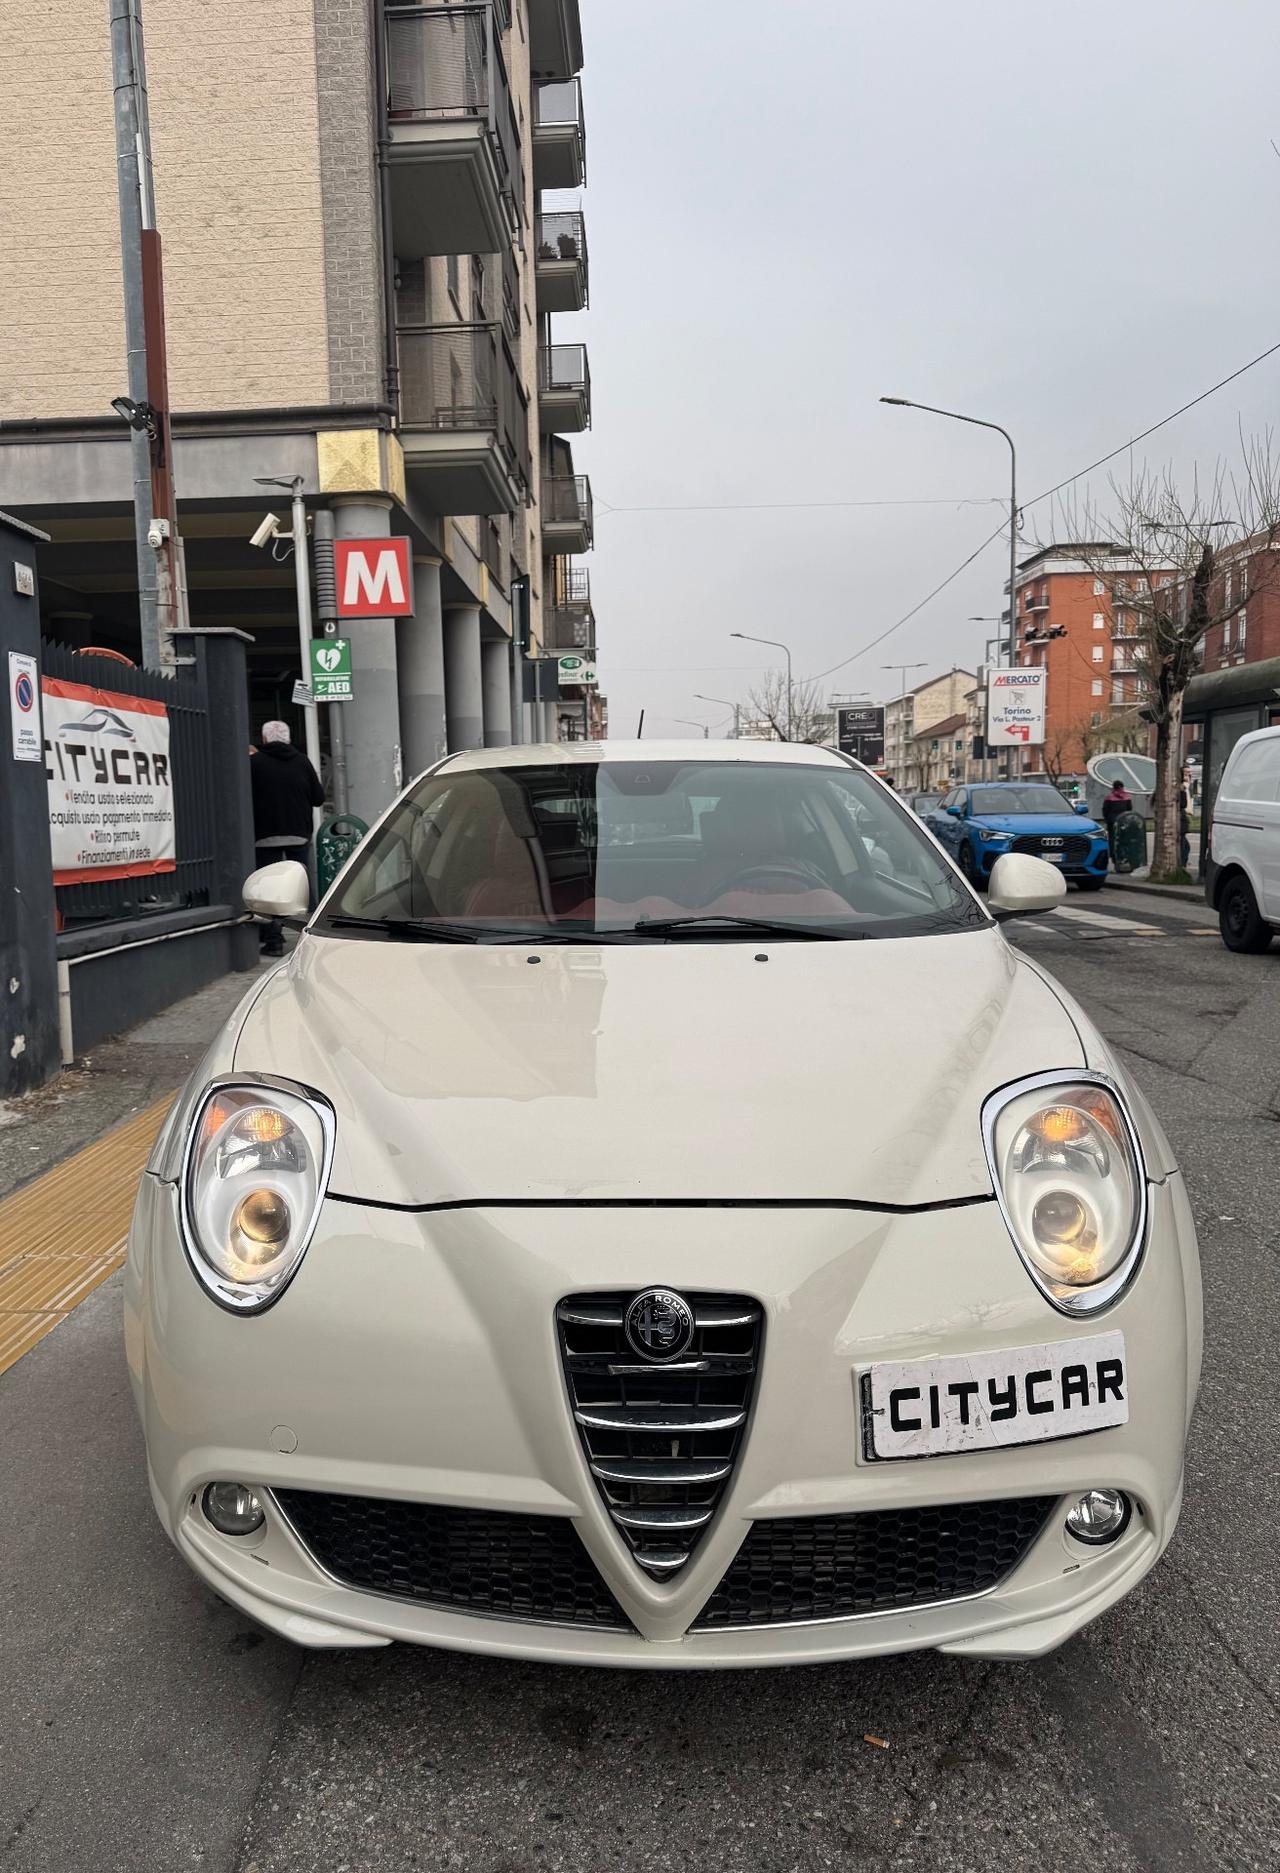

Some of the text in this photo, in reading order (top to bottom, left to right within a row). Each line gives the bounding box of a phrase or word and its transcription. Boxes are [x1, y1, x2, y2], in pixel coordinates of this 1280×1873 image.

[343, 550, 406, 605] M
[327, 682, 350, 693] AED
[1003, 706, 1031, 715] Torino
[98, 792, 115, 805] usato
[116, 790, 154, 805] selezionato
[48, 809, 81, 828] cquisto
[82, 810, 101, 825] usato
[142, 809, 173, 823] immediato
[81, 848, 128, 865] Finanziamenti
[136, 846, 151, 859] sede
[630, 1295, 689, 1327] ALFA ROMEO
[889, 1358, 1125, 1433] CITYCAR
